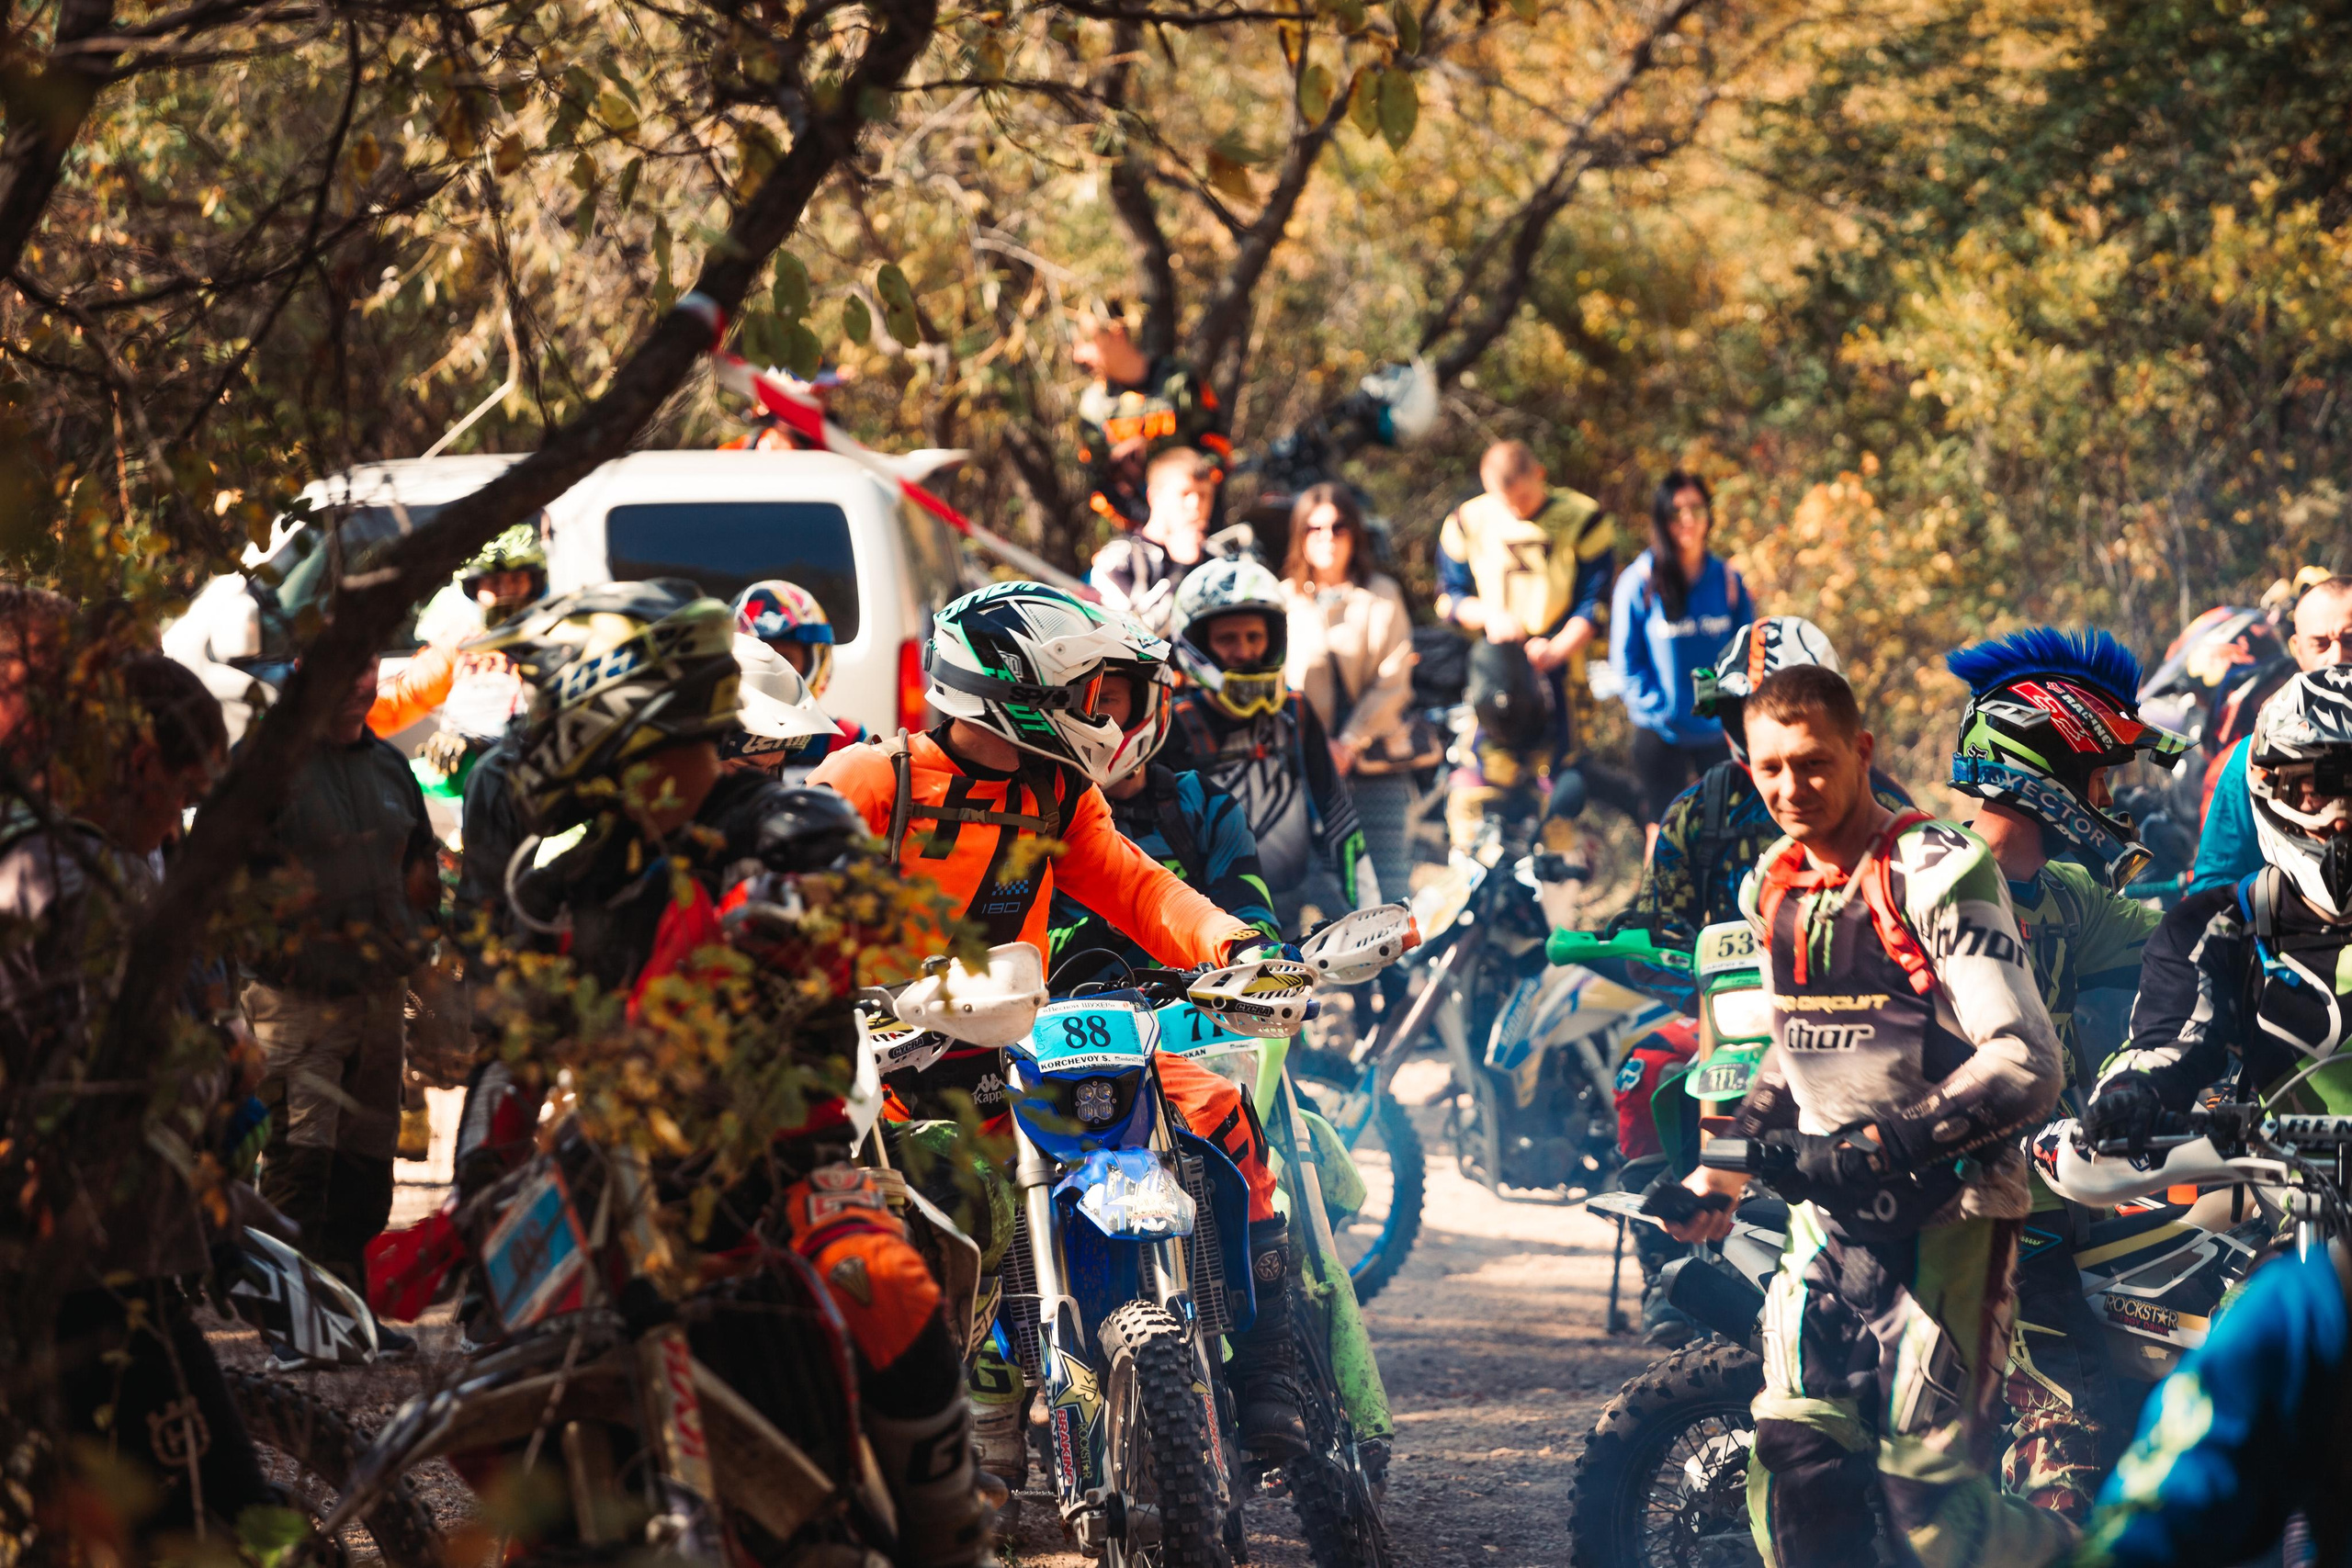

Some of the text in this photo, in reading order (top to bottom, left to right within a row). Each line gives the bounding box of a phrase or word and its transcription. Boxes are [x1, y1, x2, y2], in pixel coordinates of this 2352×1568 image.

[2061, 694, 2113, 750] RACING
[2003, 771, 2107, 848] VECTOR
[1717, 931, 1755, 958] 53
[1236, 1003, 1272, 1017] CYCRA
[1062, 1015, 1112, 1049] 88
[892, 1037, 924, 1057] CYCRA
[1180, 1048, 1206, 1060] SKAN
[1041, 1055, 1100, 1070] KORCHEVOY
[974, 1089, 1008, 1104] Kappa
[1056, 1407, 1074, 1485] BRAKING
